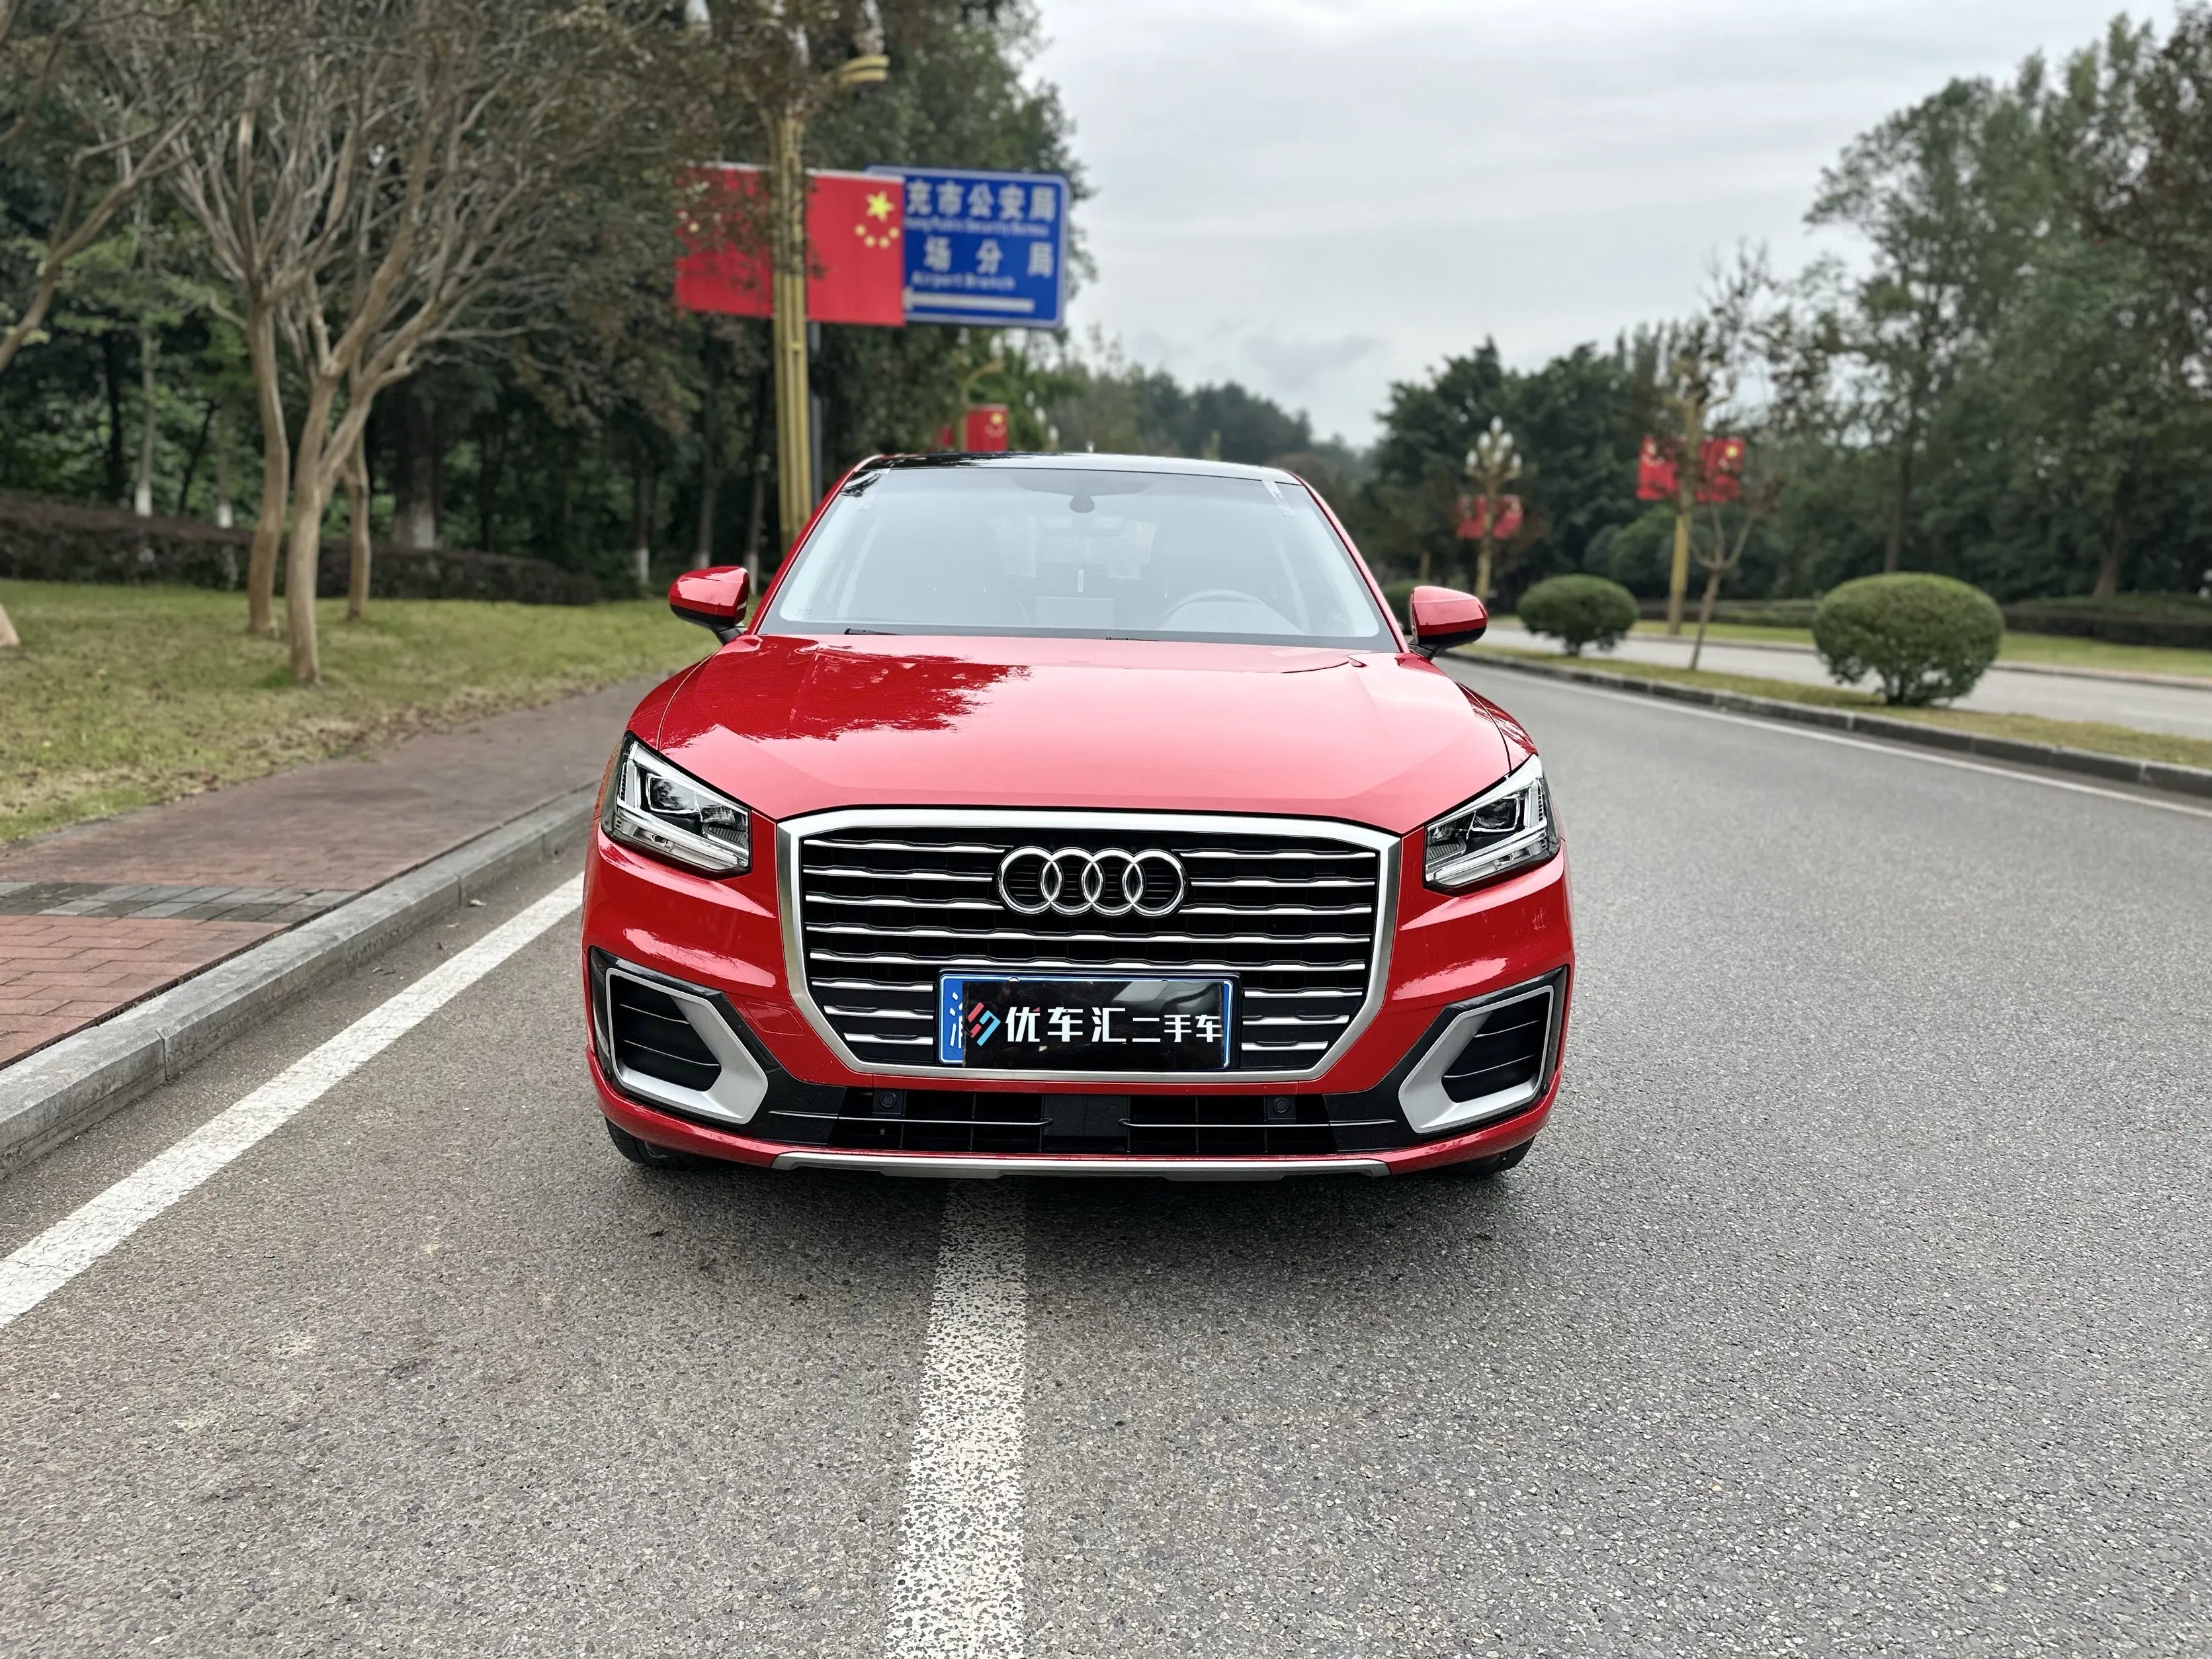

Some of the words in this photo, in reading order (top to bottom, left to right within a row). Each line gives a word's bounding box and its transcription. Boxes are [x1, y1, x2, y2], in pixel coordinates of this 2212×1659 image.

[1005, 1006, 1222, 1042] 优车汇二手车
